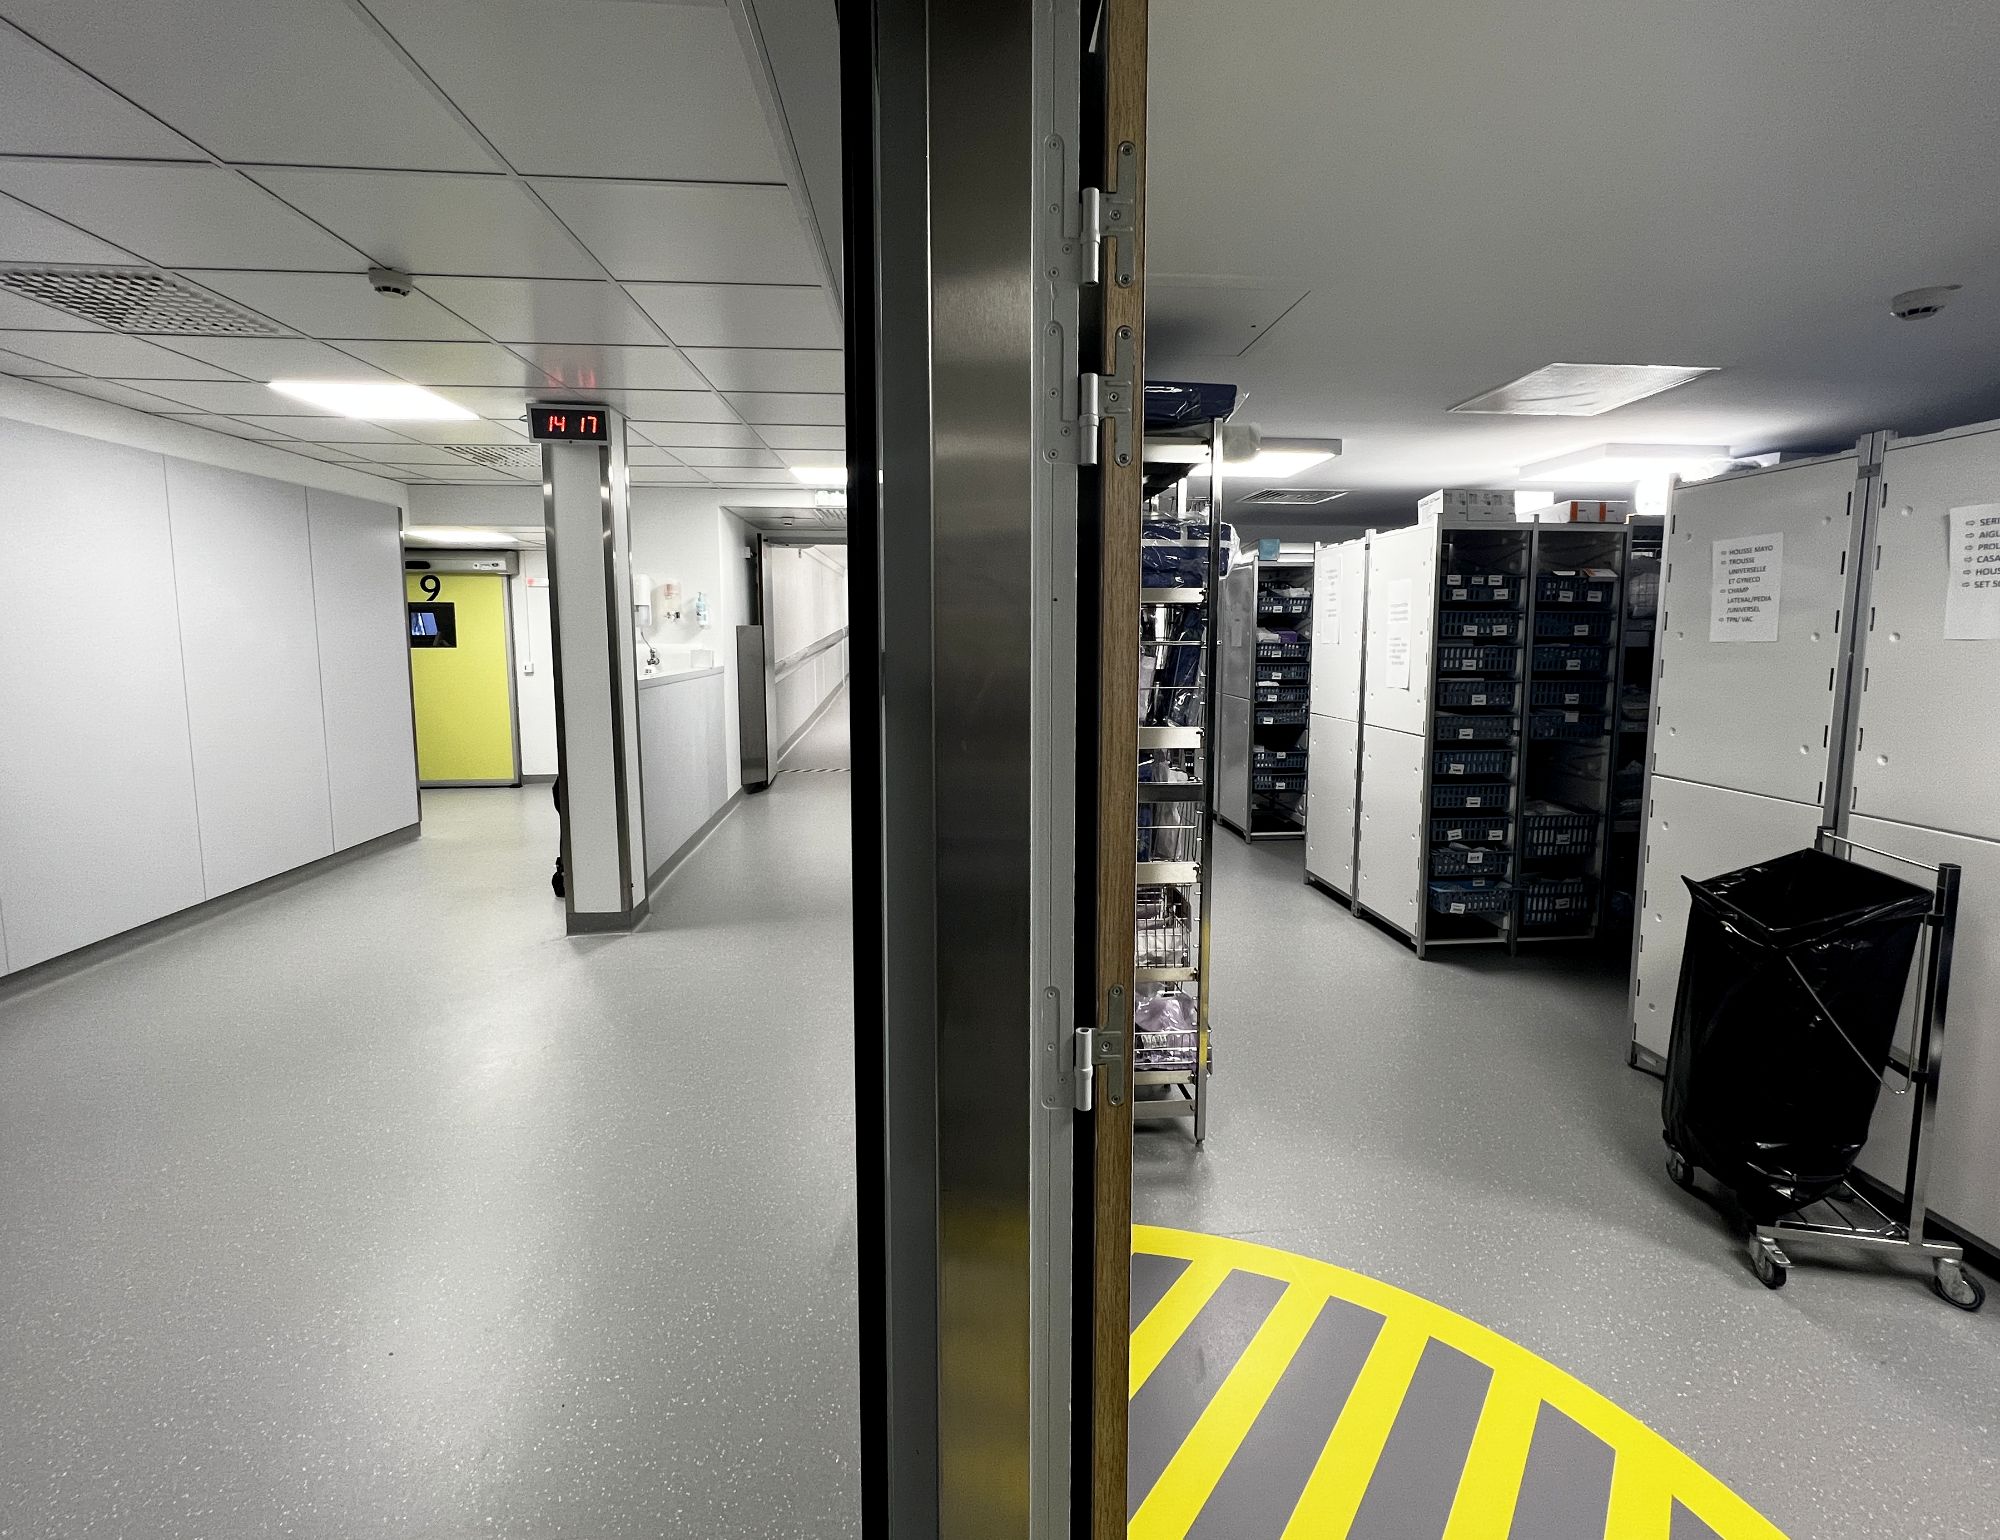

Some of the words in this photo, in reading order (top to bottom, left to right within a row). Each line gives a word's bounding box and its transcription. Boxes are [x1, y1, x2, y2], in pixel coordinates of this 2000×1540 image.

[548, 415, 566, 432] 14
[580, 415, 598, 434] 17
[1729, 566, 1767, 575] UNIVERSELLE
[420, 574, 442, 602] 9
[1974, 580, 1990, 588] SET
